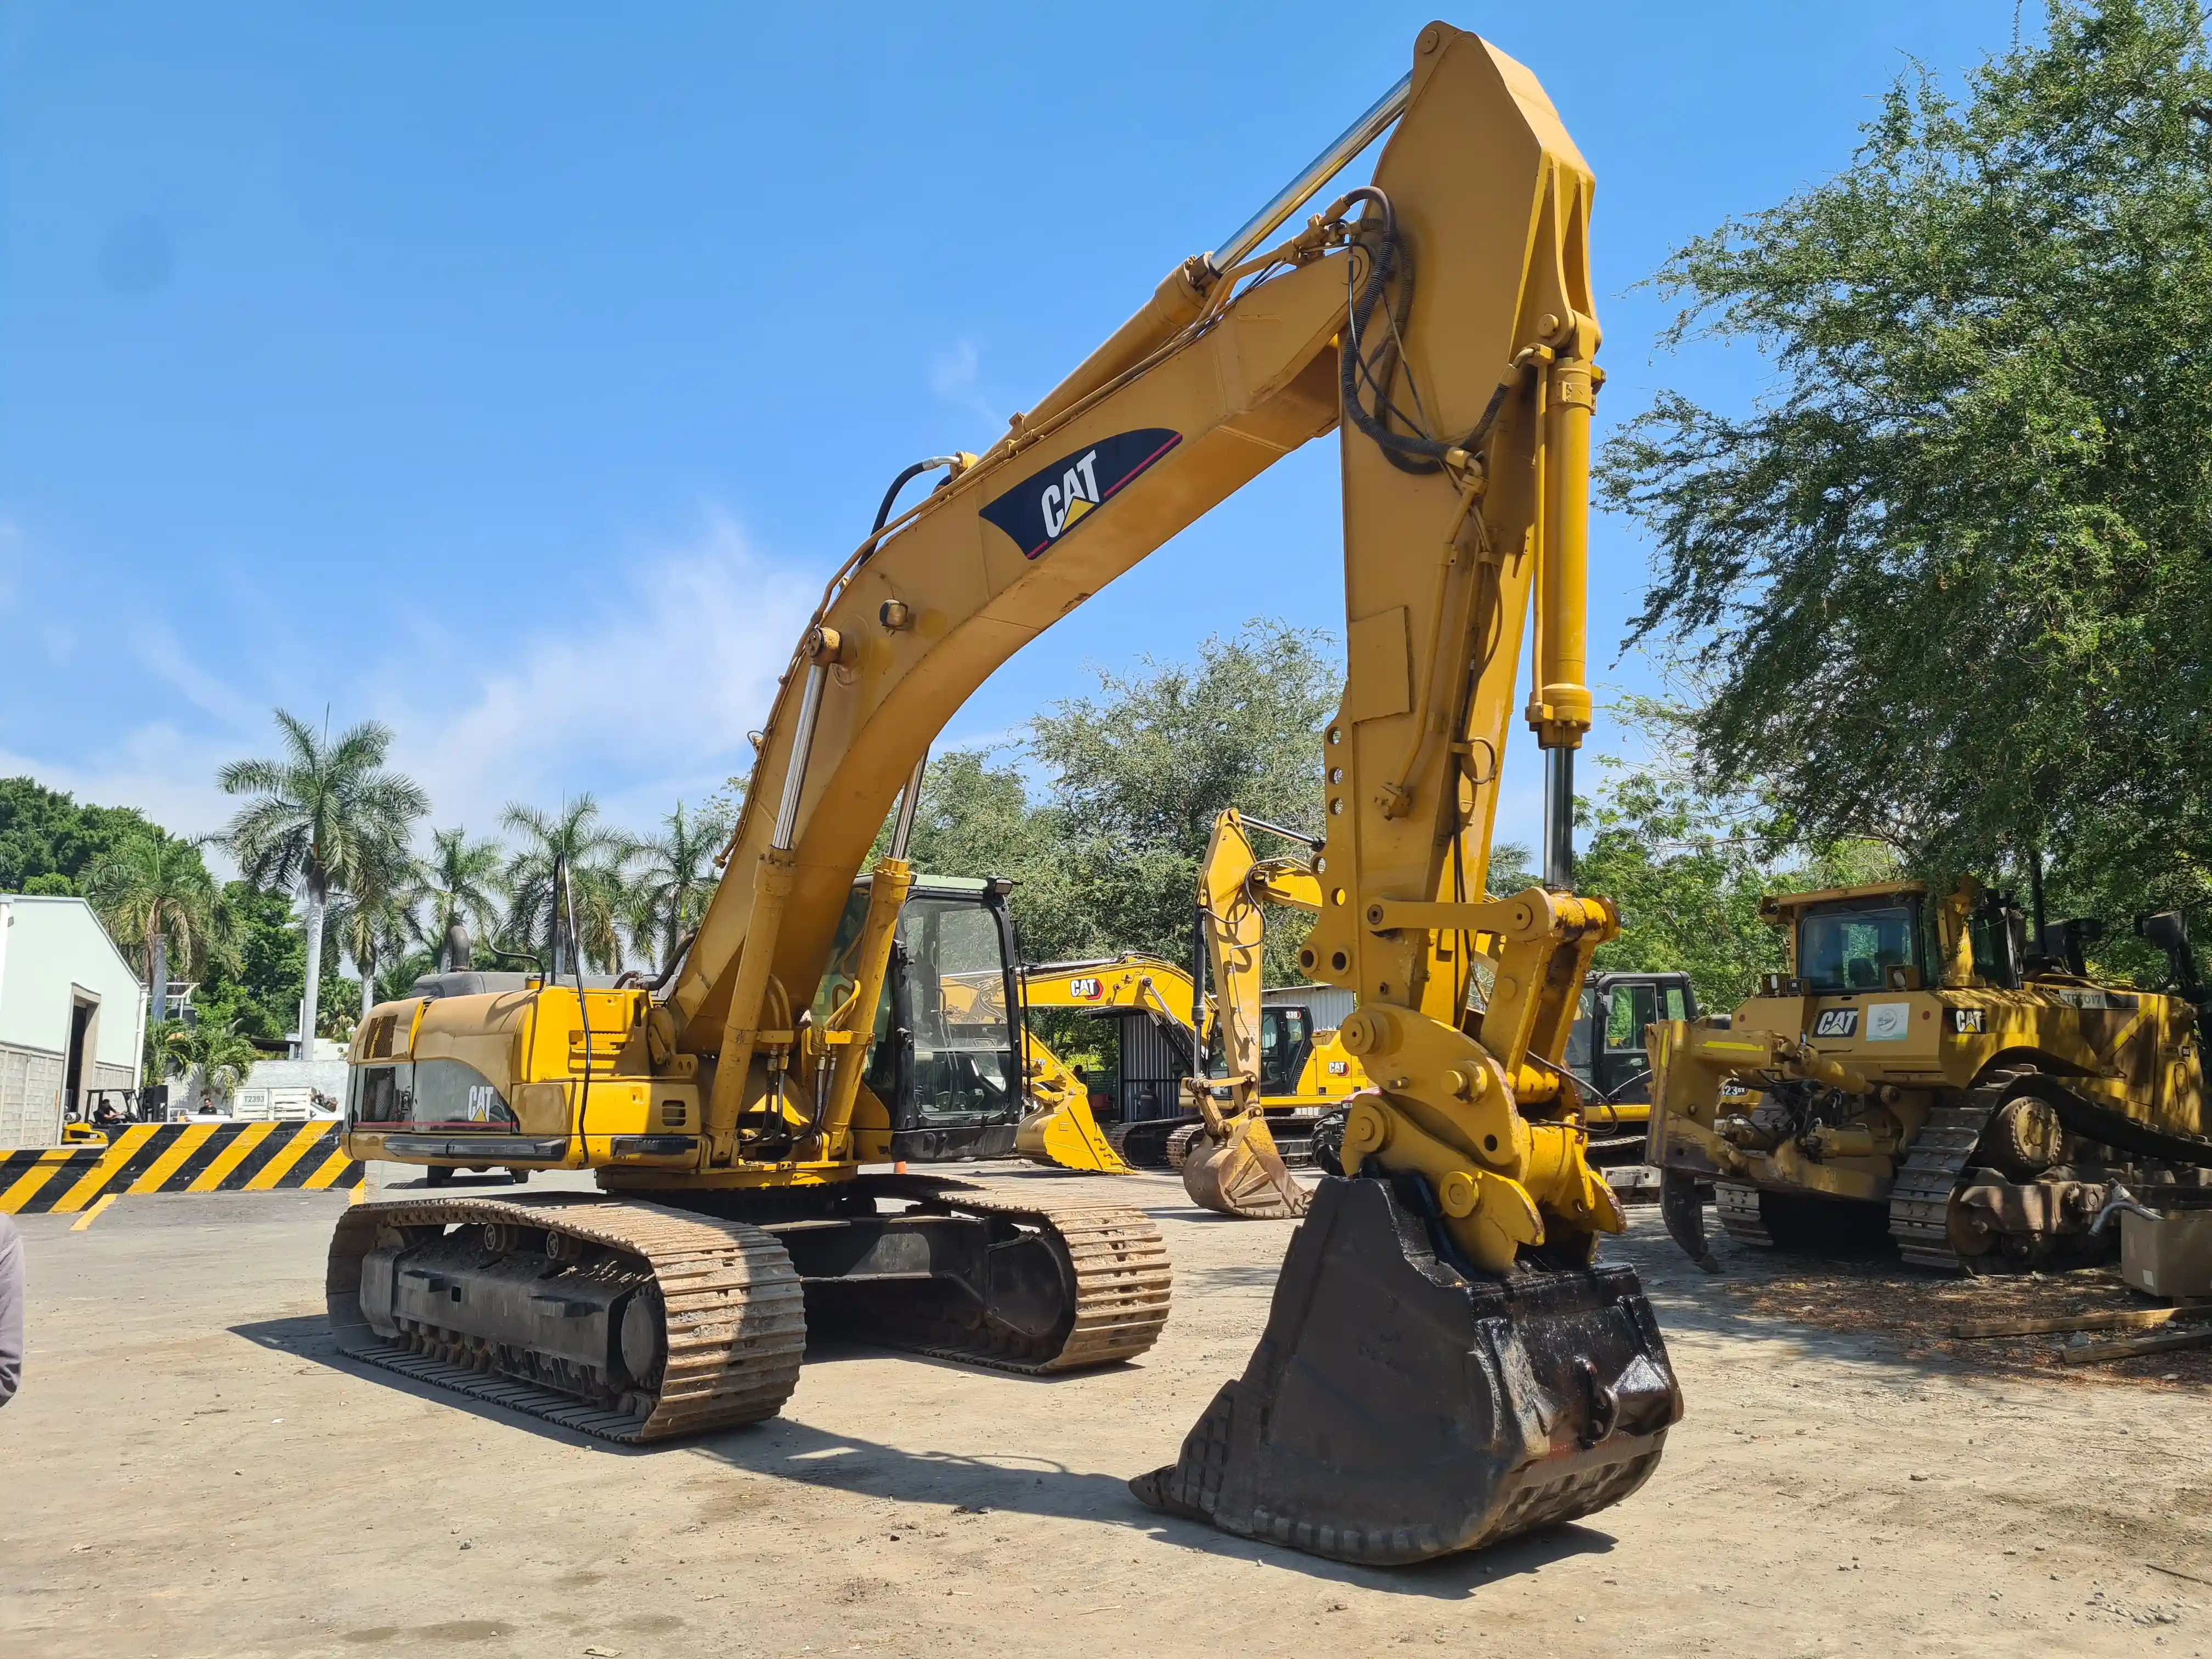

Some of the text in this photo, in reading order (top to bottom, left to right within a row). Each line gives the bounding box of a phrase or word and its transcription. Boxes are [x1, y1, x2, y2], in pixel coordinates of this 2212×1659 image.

[1041, 449, 1099, 538] CAT
[1070, 979, 1095, 996] CAT
[1817, 1011, 1859, 1035] CAT
[1956, 1010, 1982, 1032] CAT
[1329, 1062, 1345, 1074] CAT
[467, 1085, 494, 1122] CAT
